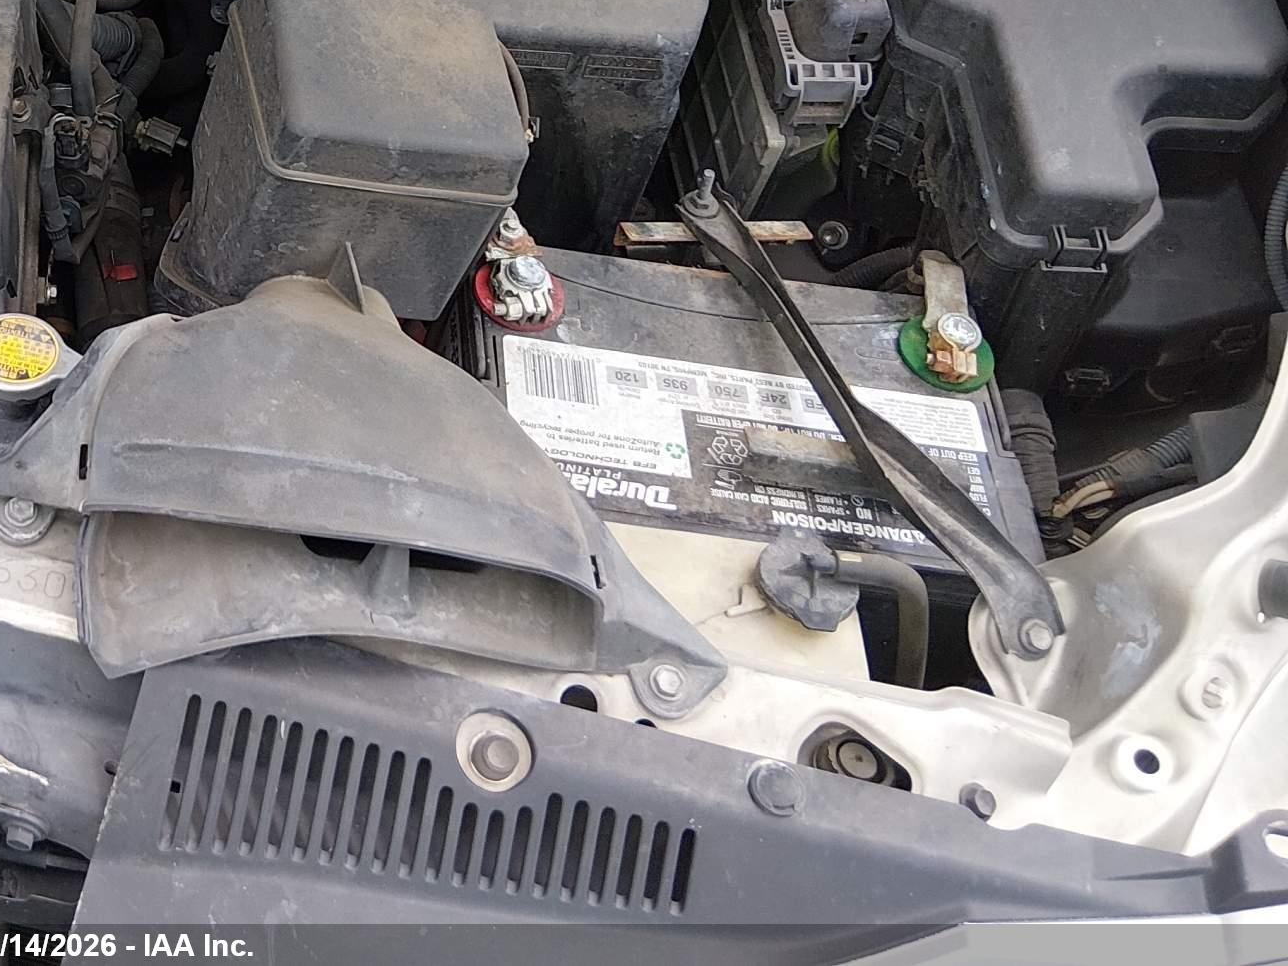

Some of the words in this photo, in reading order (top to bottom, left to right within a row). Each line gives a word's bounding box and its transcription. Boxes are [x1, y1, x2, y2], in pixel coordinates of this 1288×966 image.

[615, 370, 639, 383] 120
[663, 378, 688, 390] 935
[714, 385, 740, 398] 750
[804, 398, 823, 410] FB
[520, 420, 562, 434] recycling
[565, 424, 595, 438] proper
[546, 432, 556, 441] to
[558, 434, 600, 450] batteries
[598, 432, 611, 441] for
[613, 434, 660, 447] AutoZone
[602, 441, 625, 450] used
[628, 445, 660, 456] Return
[542, 447, 628, 465] TECHNOLOGY
[928, 448, 938, 456] OF
[940, 449, 955, 460] OUT
[959, 452, 977, 462] KEEP
[555, 462, 621, 480] PLATINU
[633, 460, 657, 470] EFB
[562, 472, 677, 510] Durala
[710, 488, 734, 500] CAUSE
[734, 491, 749, 502] CAN
[751, 494, 769, 505] ACID
[770, 496, 807, 510] SULFURIC
[814, 494, 842, 505] FLAMES
[817, 504, 844, 516] SPARKS
[855, 507, 872, 520] NO
[772, 510, 913, 543] DANGER/POISON
